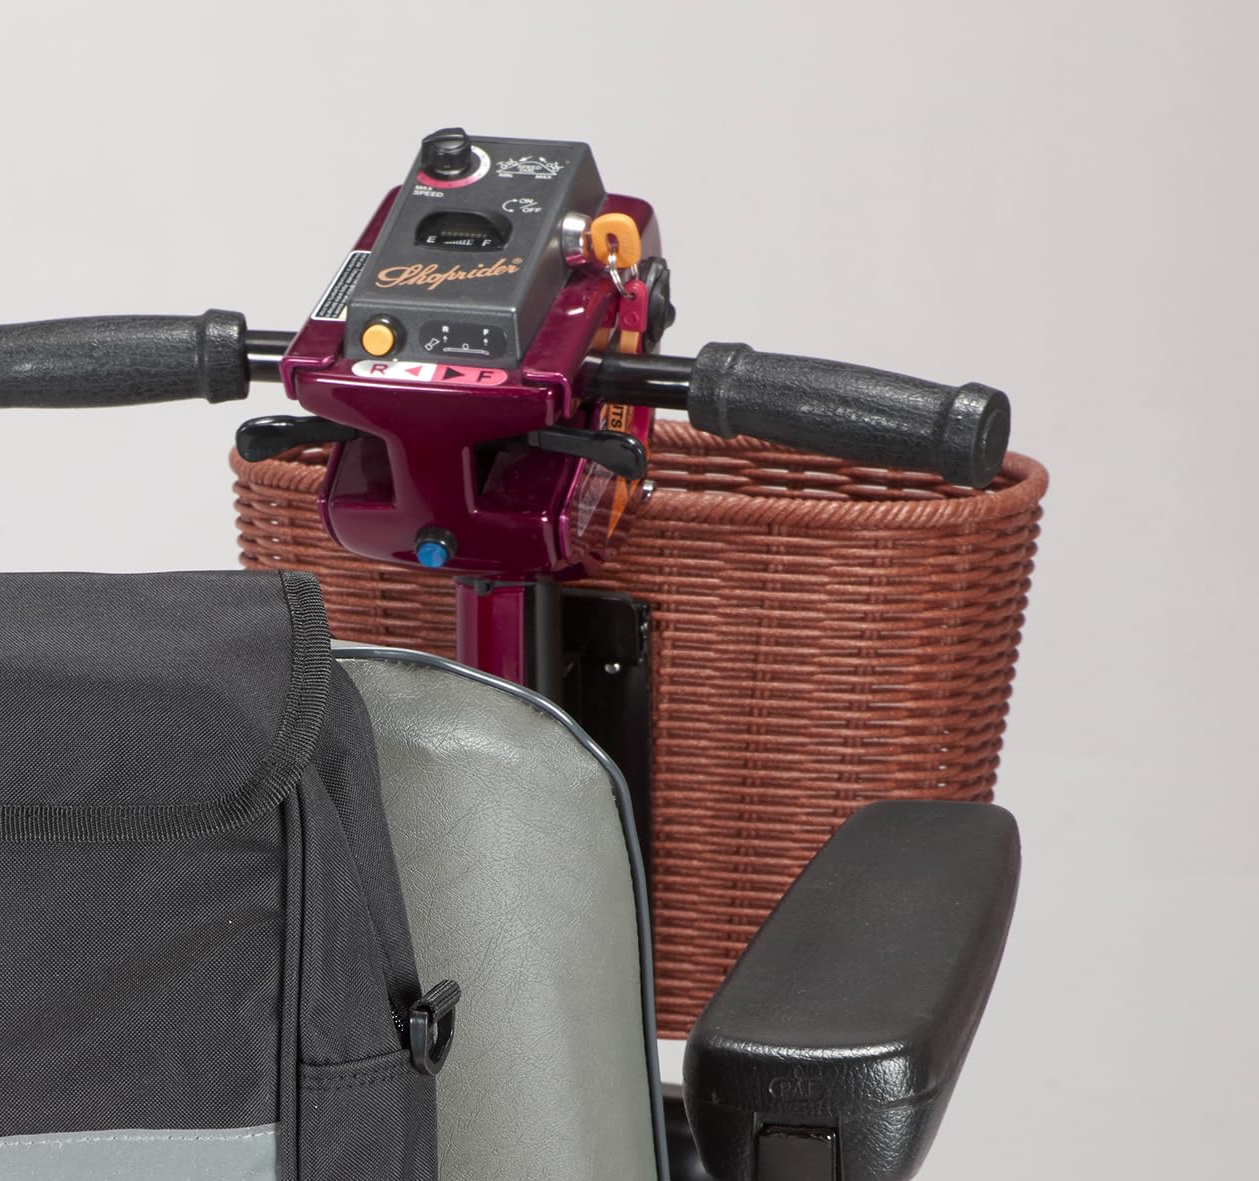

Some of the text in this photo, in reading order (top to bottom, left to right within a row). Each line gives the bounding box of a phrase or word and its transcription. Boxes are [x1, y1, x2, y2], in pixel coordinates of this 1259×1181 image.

[413, 189, 444, 198] SPEED
[426, 235, 437, 243] E
[370, 363, 389, 375] R
[477, 370, 494, 382] F
